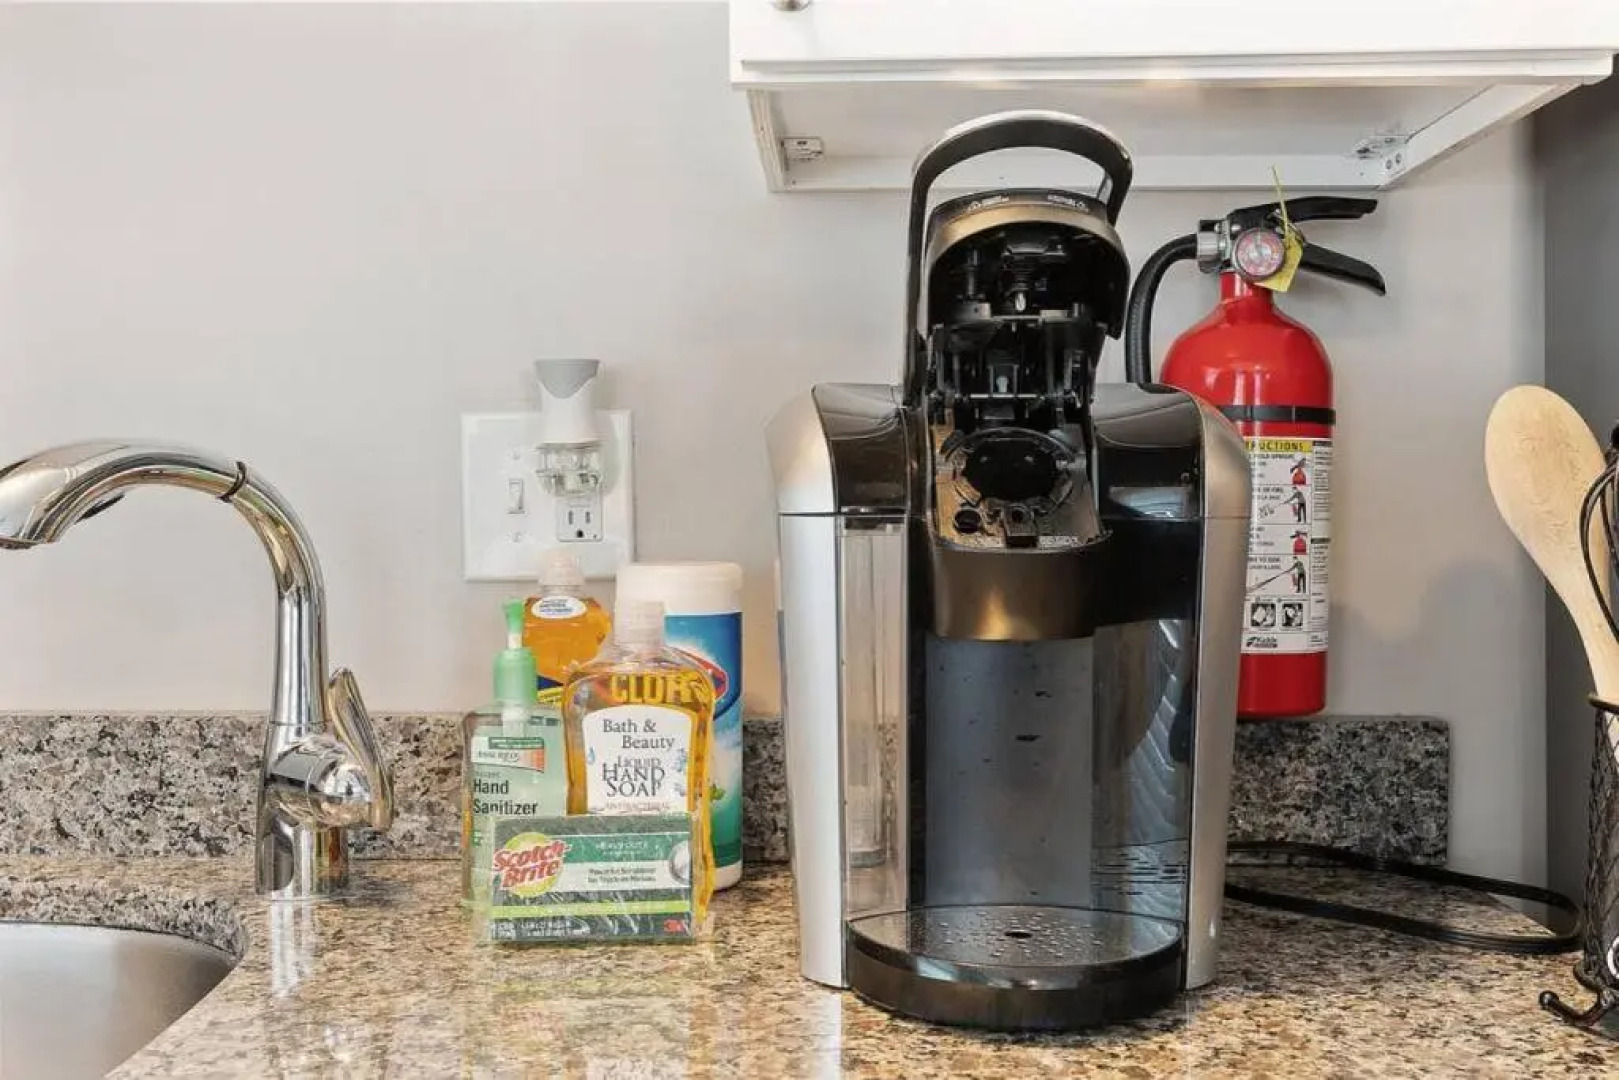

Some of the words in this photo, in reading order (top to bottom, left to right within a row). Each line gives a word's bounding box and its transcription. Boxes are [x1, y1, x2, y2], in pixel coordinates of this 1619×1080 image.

[603, 718, 637, 733] Bath
[643, 719, 657, 733] &
[622, 735, 675, 750] Beauty
[602, 763, 666, 782] HAND
[473, 779, 510, 795] Hand
[606, 776, 661, 798] SOAP
[473, 799, 539, 815] Sanitizer
[502, 859, 560, 888] Brite
